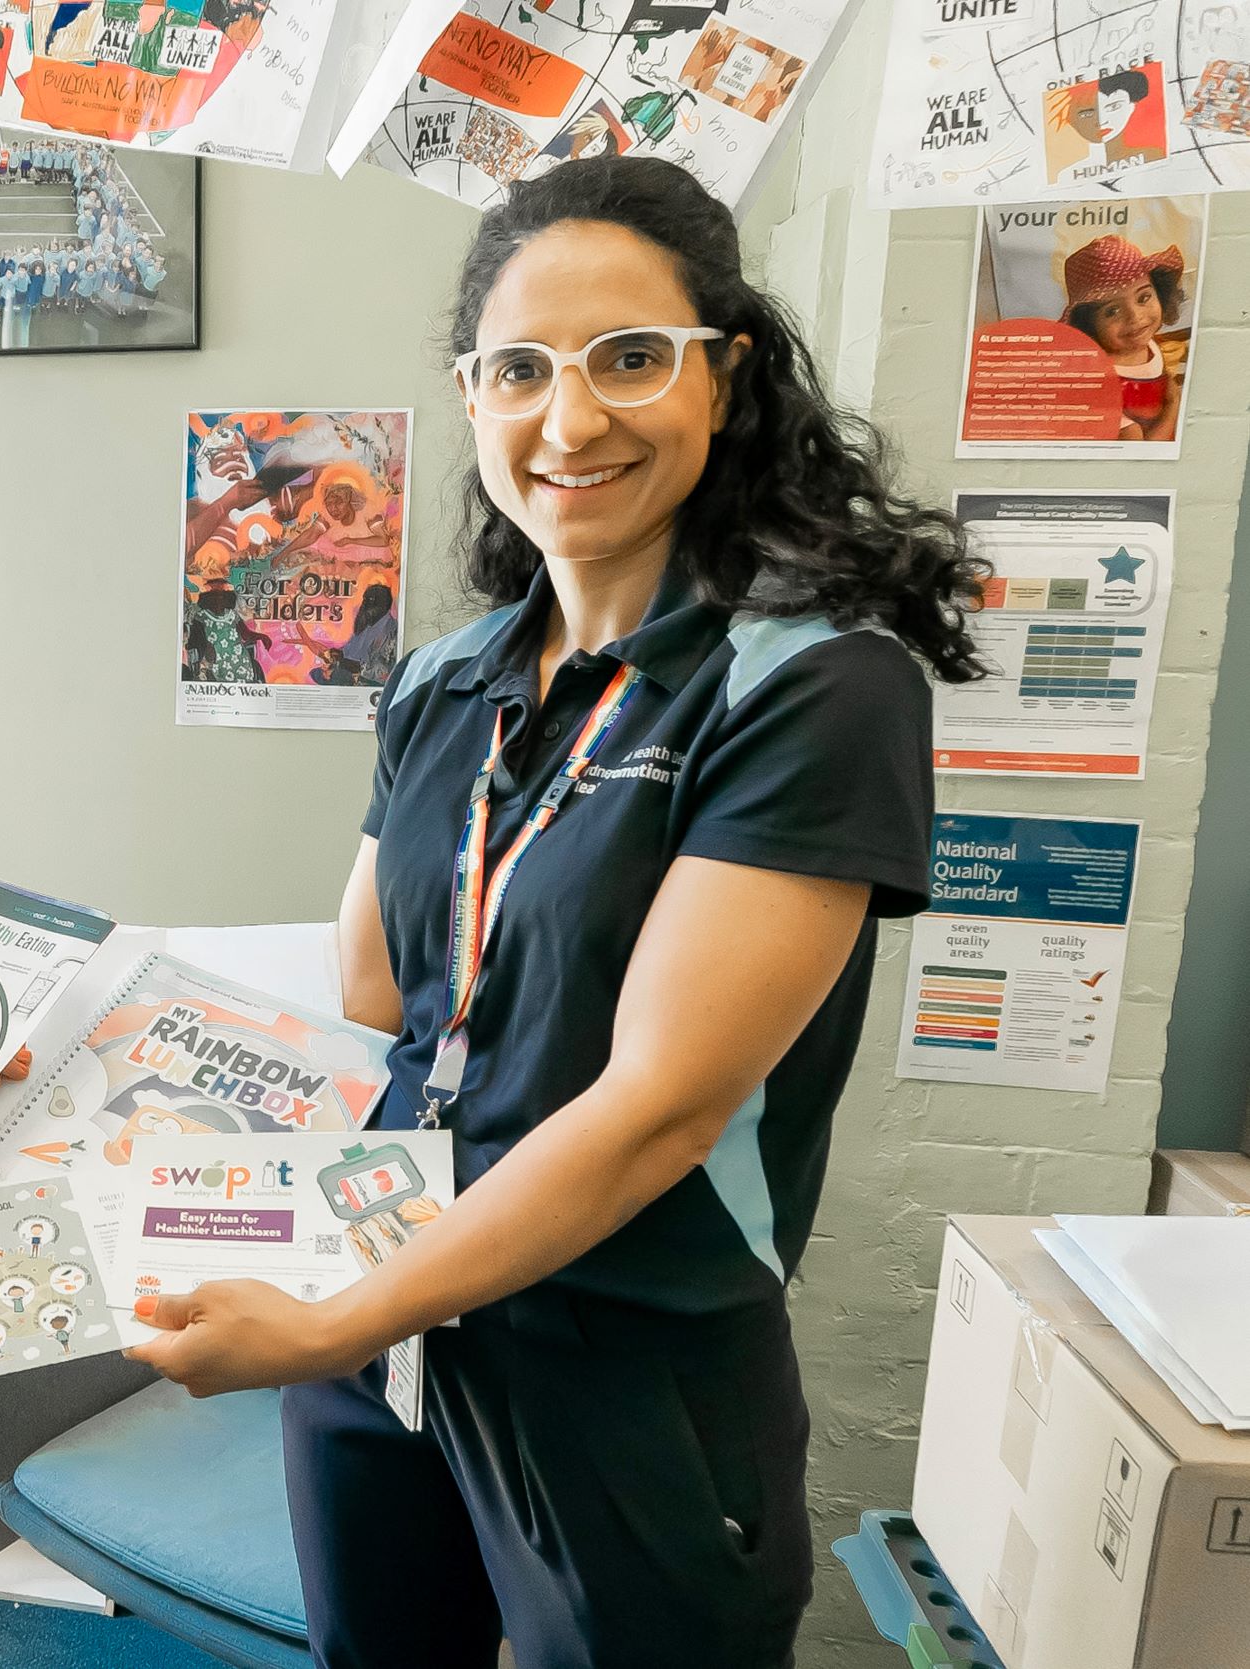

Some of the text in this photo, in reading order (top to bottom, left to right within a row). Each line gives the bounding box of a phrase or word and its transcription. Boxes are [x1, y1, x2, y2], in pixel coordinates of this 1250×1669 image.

[941, 0, 1018, 22] UNITE
[104, 17, 136, 32] WE ARE
[98, 30, 130, 49] ALL
[92, 46, 131, 64] HUMAN
[166, 51, 208, 69] UNITE
[467, 28, 498, 61] NO
[499, 42, 551, 86] WAY!
[43, 70, 177, 108] BULLYING NO WAY!
[1046, 73, 1085, 91] ONE
[926, 88, 988, 111] WE ARE
[415, 110, 456, 129] WE ARE
[927, 106, 982, 135] ALL
[415, 126, 451, 149] ALL
[920, 128, 989, 151] HUMAN
[412, 144, 454, 161] HUMAN
[1073, 153, 1145, 181] HUMAN
[1000, 206, 1129, 232] your child
[237, 571, 358, 599] For Our
[247, 594, 344, 622] Elders
[185, 684, 272, 698] NAIDOC Week
[936, 839, 1017, 861] National
[934, 861, 1002, 885] Quality
[931, 881, 1019, 903] Standard
[951, 924, 988, 934] seven
[15, 931, 57, 957] Eating
[946, 934, 990, 949] quality
[1041, 934, 1087, 948] quality
[949, 948, 985, 960] areas
[1040, 949, 1086, 962] ratings
[171, 1006, 201, 1023] MY
[148, 1016, 328, 1098] RAINBOW
[128, 1037, 318, 1127] LUNCHBOX
[174, 1189, 212, 1199] everyday
[237, 1189, 250, 1197] the
[253, 1189, 293, 1198] lunchbox
[179, 1211, 260, 1226] Easy Ideas for
[155, 1222, 282, 1238] Healthier Lunchboxes
[134, 1286, 161, 1297] NSW
